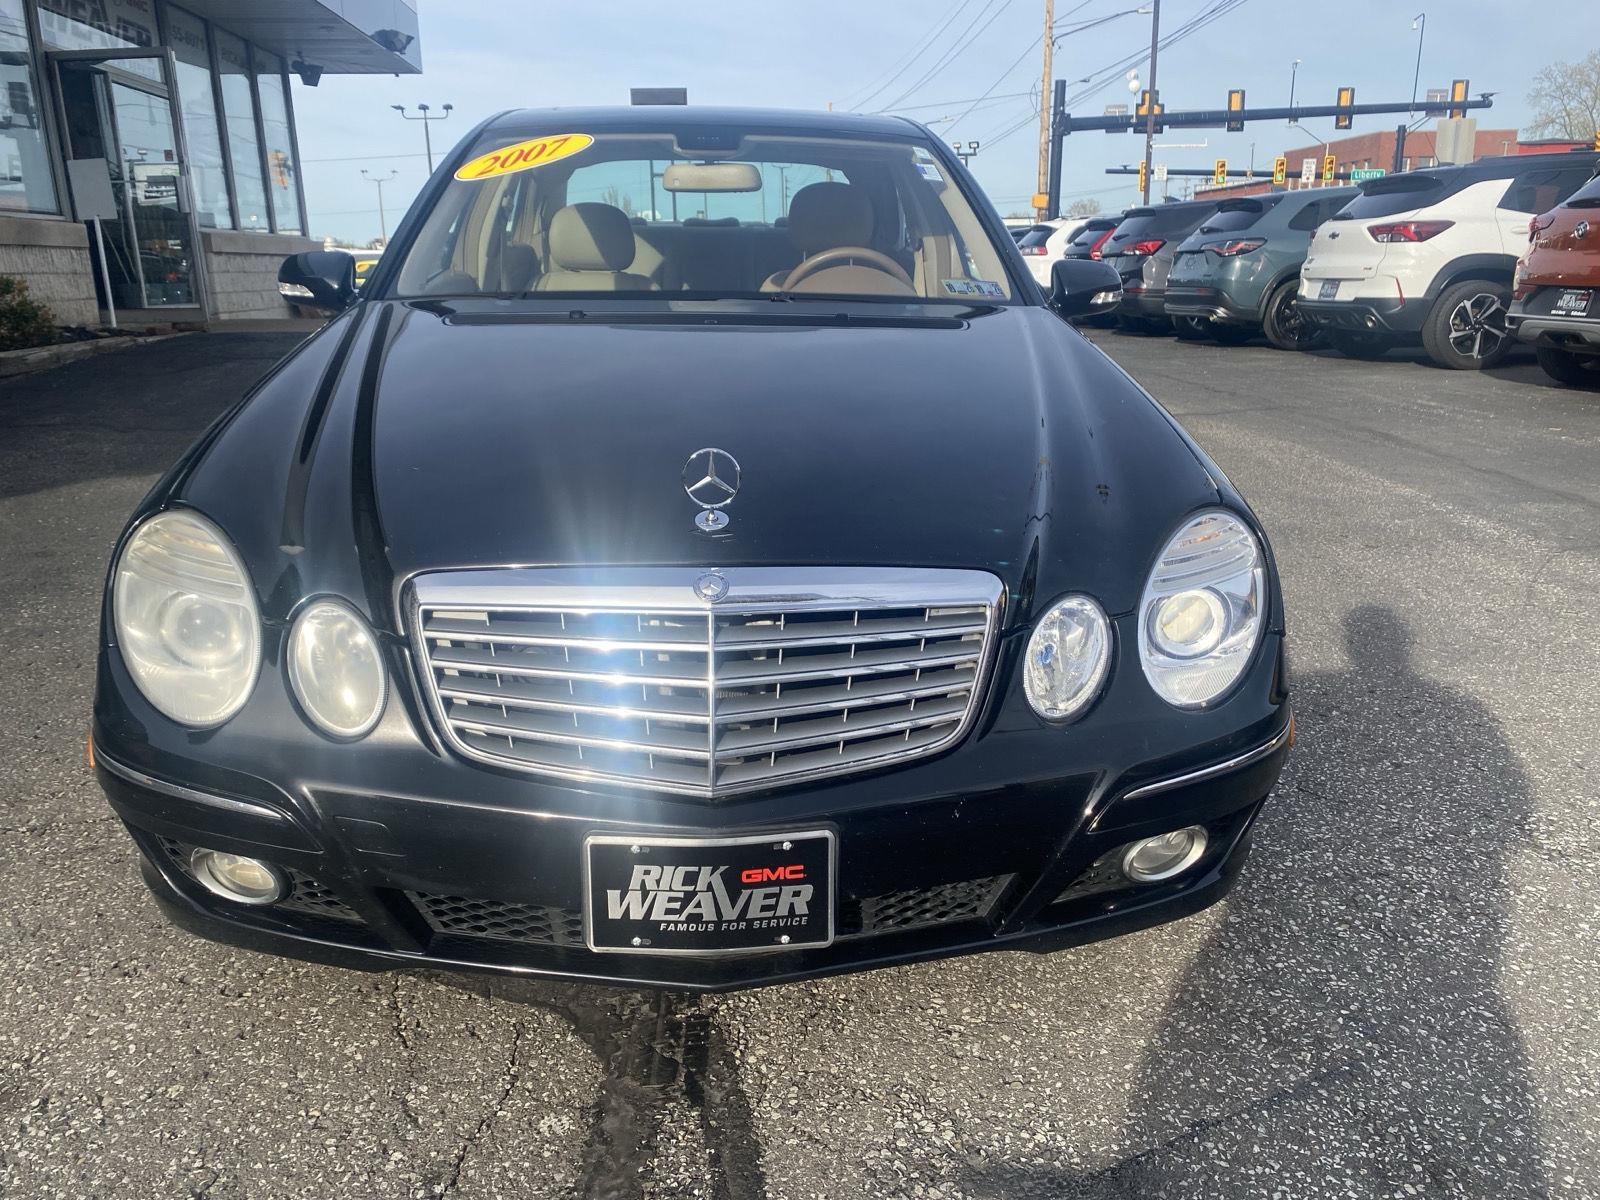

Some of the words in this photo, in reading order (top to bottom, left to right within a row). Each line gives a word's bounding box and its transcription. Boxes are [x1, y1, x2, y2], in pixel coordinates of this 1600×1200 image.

[475, 136, 572, 177] 2007
[1354, 171, 1381, 179] Liberty
[629, 864, 731, 892] RICK
[741, 865, 806, 884] GMC
[607, 884, 814, 922] WEAVER
[660, 922, 715, 932] FAMOUS
[722, 921, 747, 931] FOR
[753, 916, 808, 930] SERVICE
